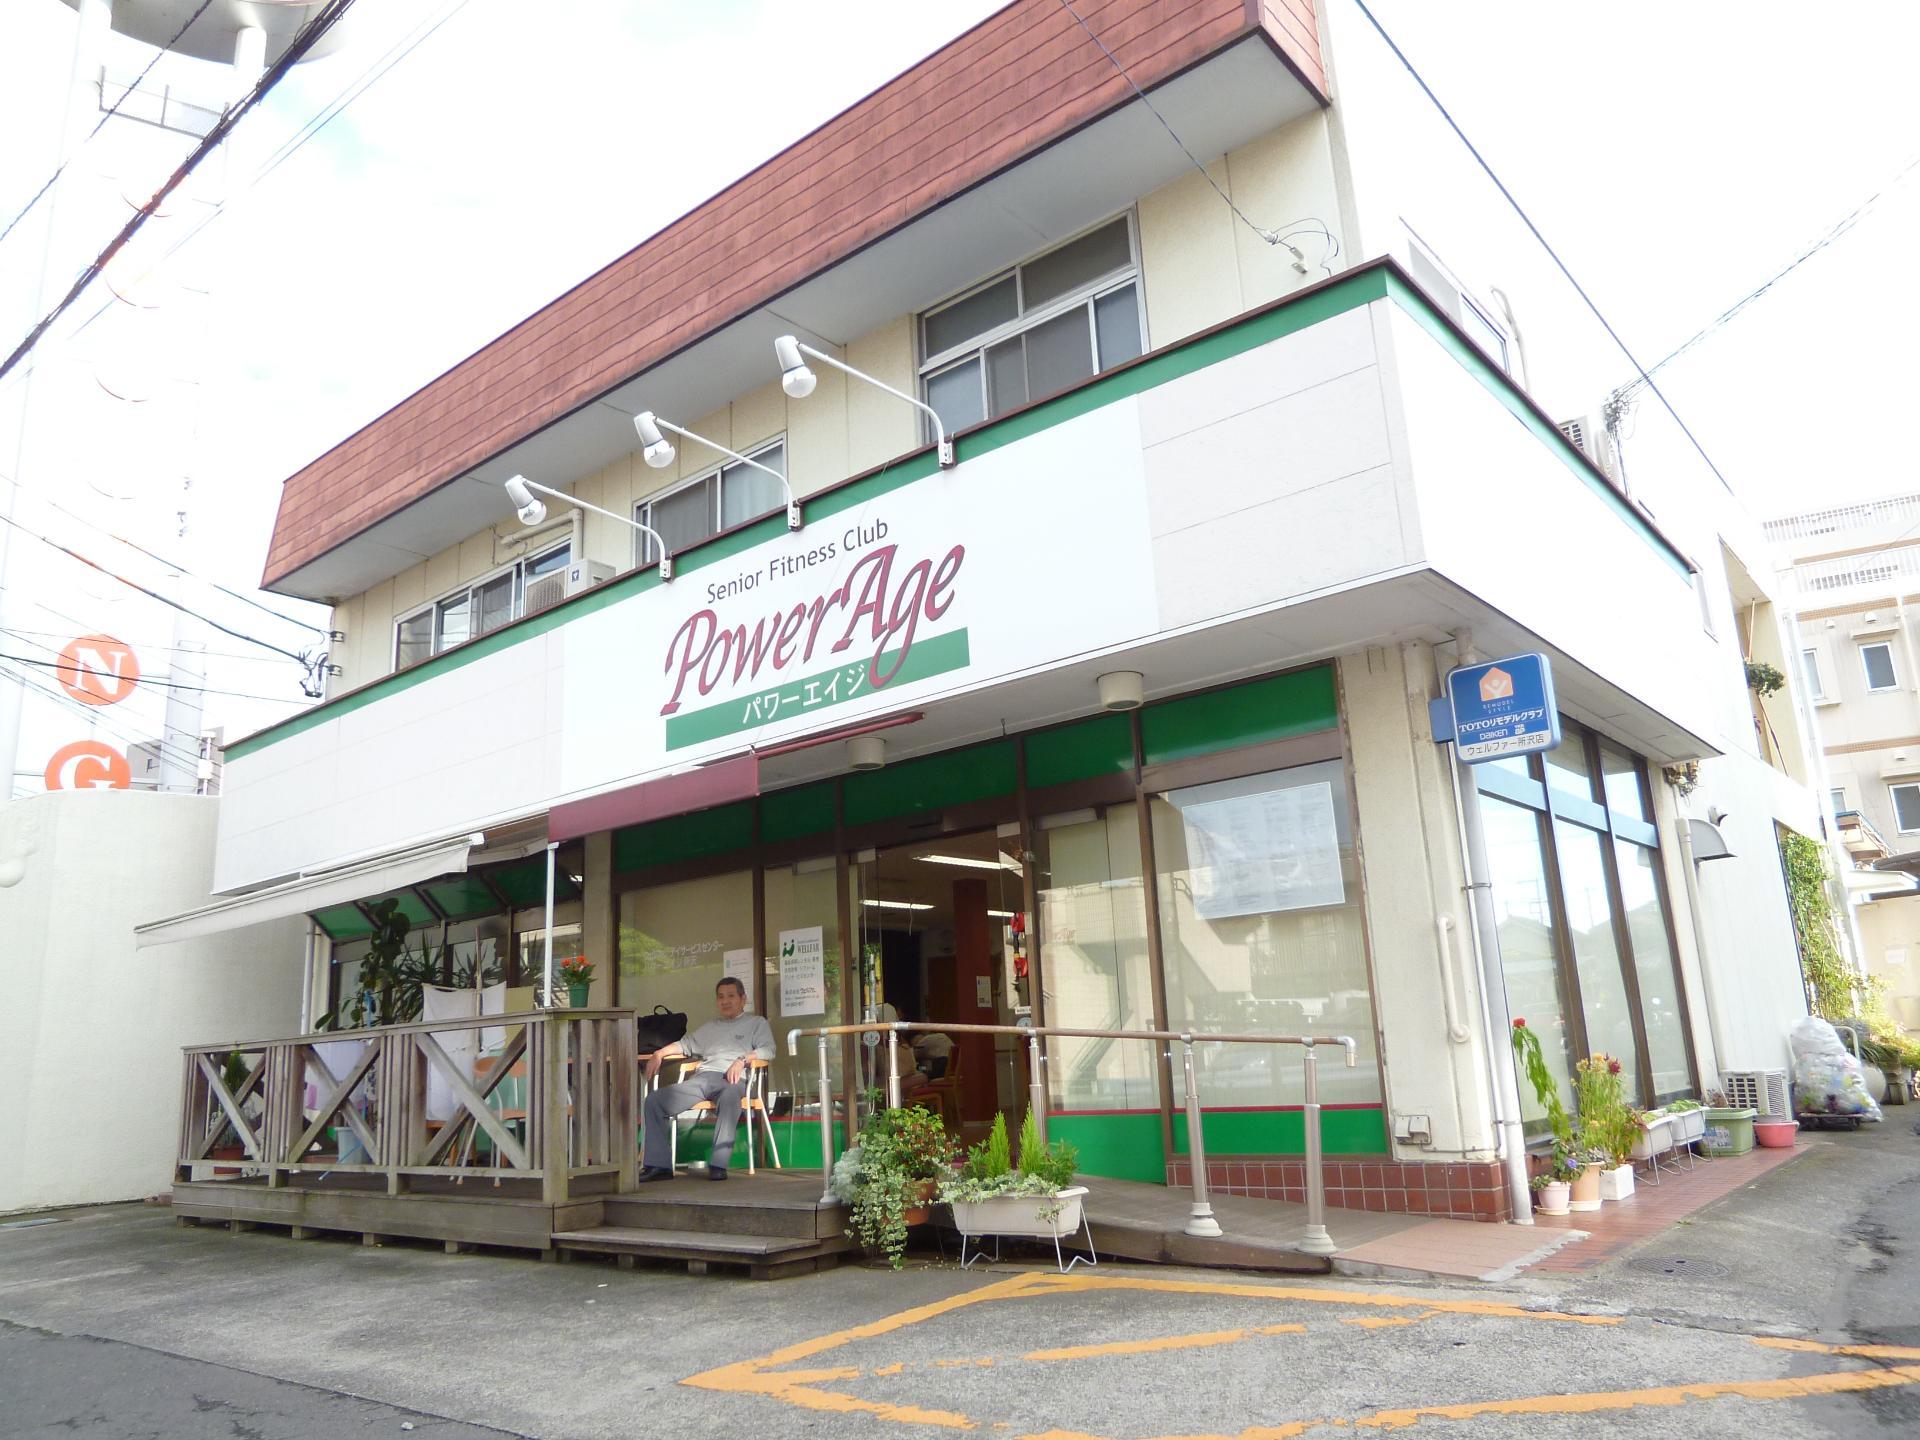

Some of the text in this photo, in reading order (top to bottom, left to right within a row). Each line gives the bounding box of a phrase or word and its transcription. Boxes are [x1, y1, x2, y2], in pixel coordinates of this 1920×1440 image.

[707, 518, 888, 604] Senior Fitness Club
[68, 646, 128, 695] N
[742, 664, 866, 724] パワーエイジ
[1458, 708, 1545, 733] TOTOリモデルクラブ
[1467, 734, 1544, 756] ウェルファー所沢店
